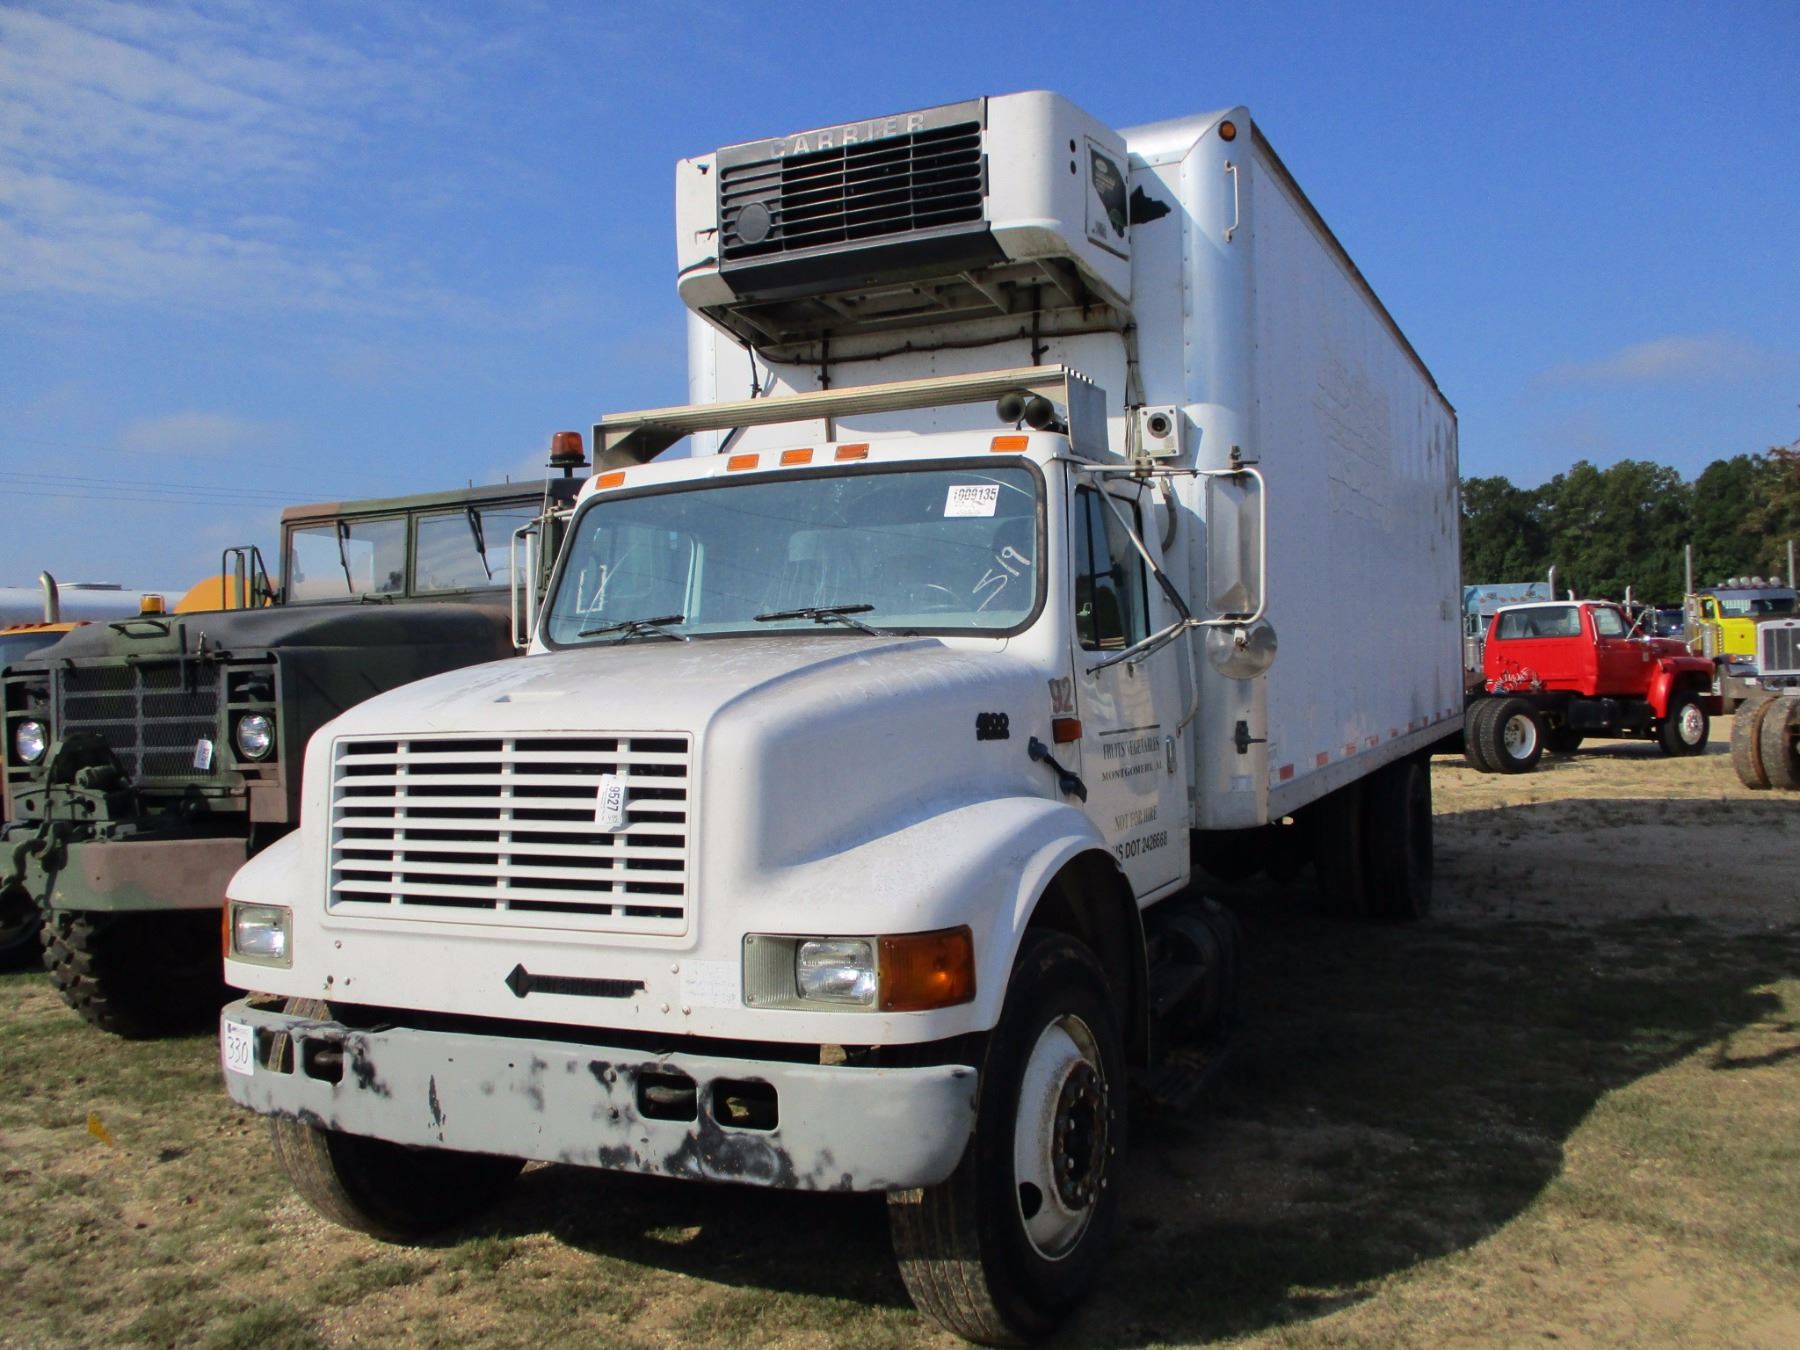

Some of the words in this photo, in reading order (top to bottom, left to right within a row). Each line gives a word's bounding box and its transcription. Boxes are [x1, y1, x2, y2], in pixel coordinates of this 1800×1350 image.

[769, 113, 925, 159] CARRIER
[1103, 740, 1126, 760] FRUITS
[606, 786, 620, 811] 9527
[1125, 838, 1142, 858] DOT
